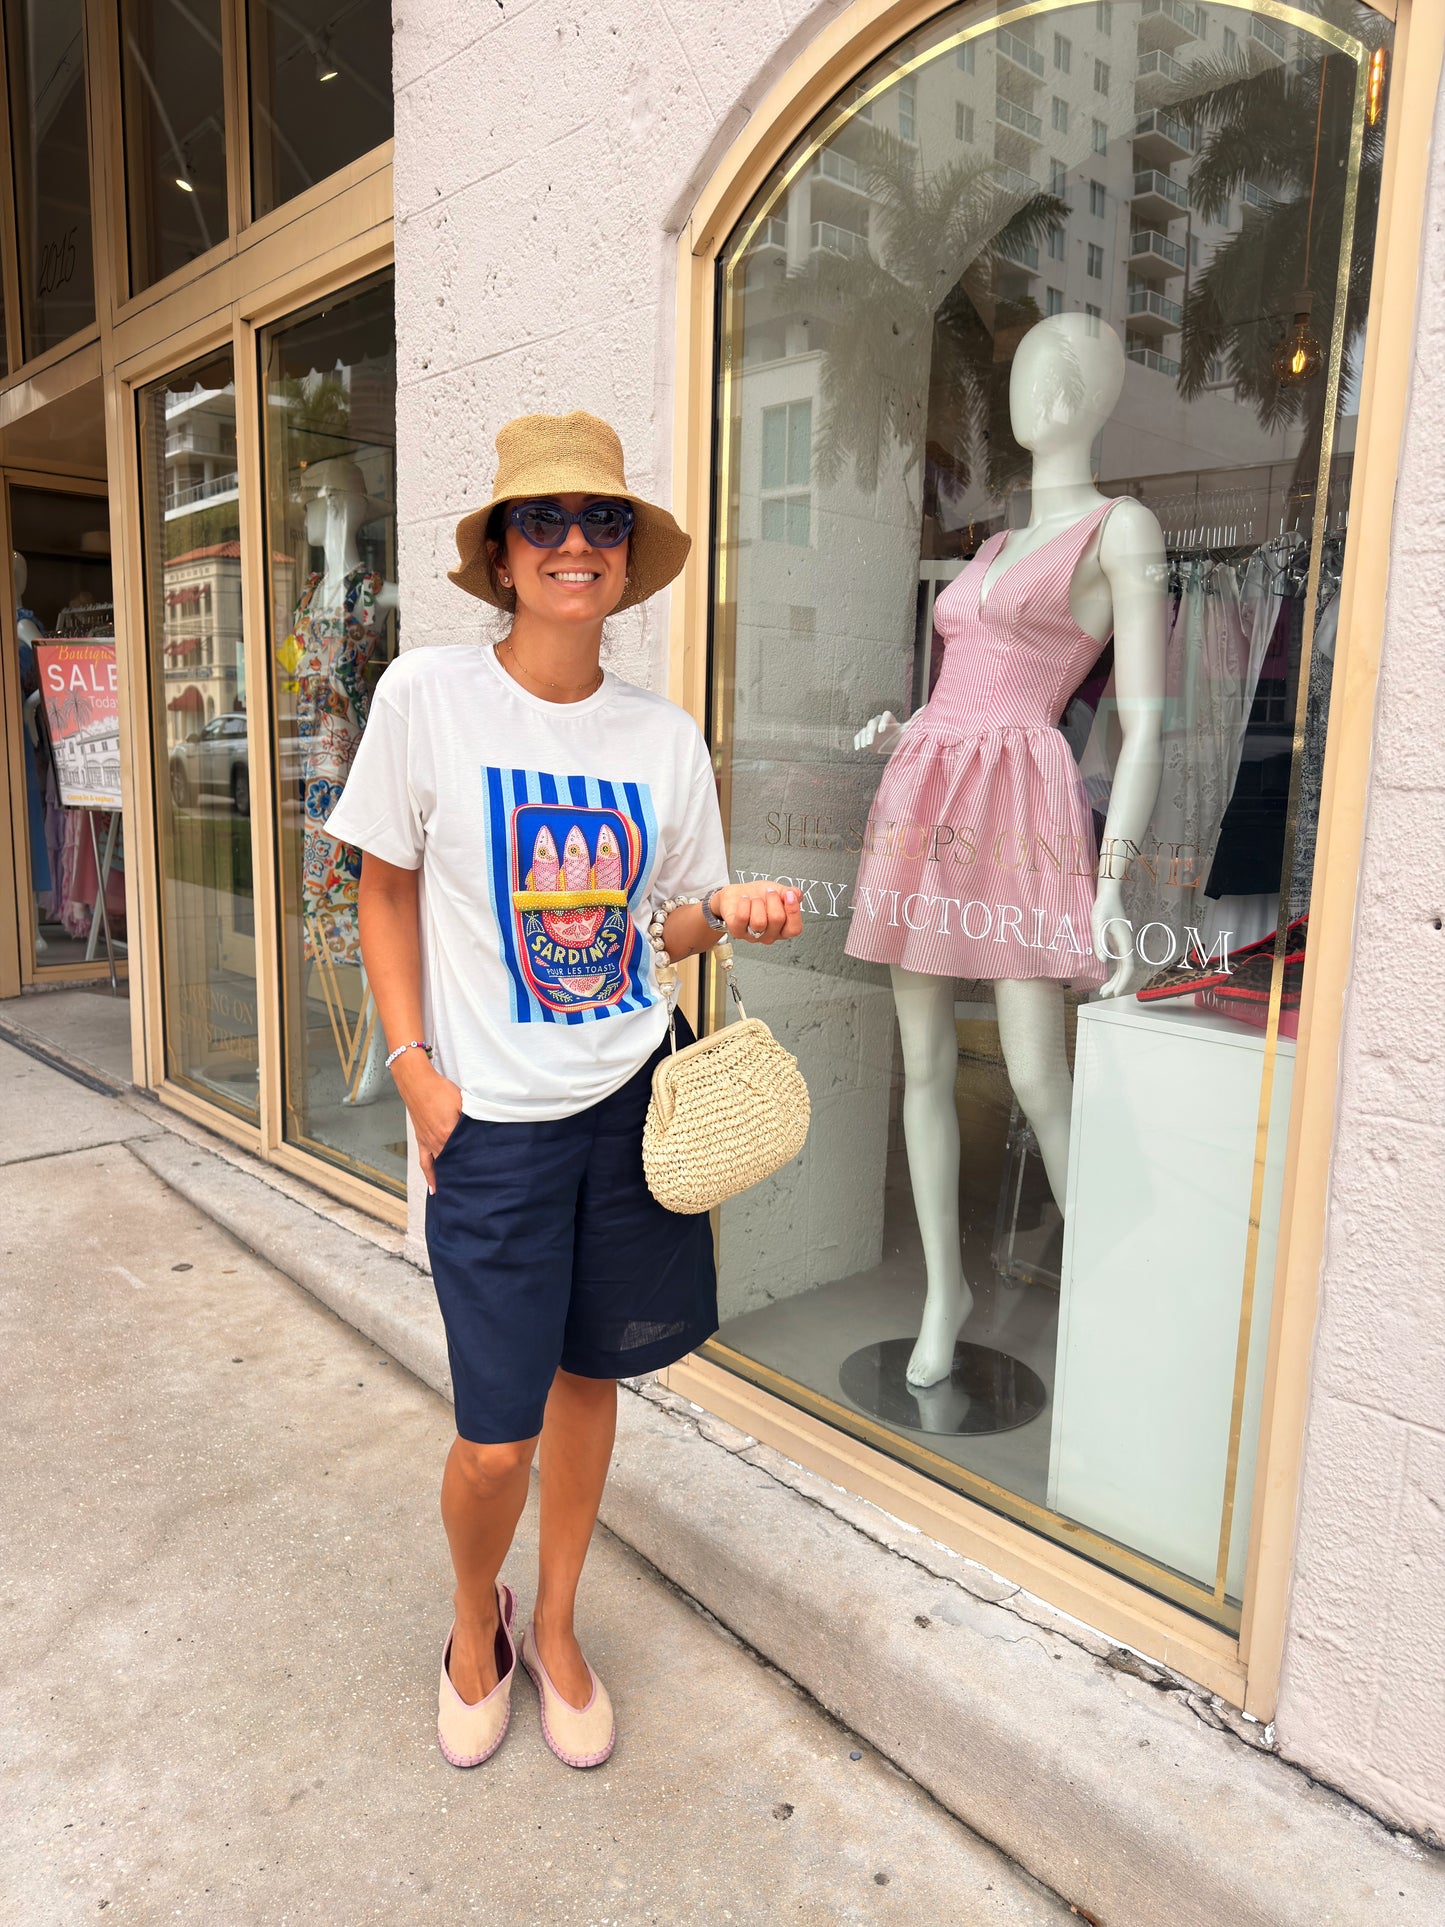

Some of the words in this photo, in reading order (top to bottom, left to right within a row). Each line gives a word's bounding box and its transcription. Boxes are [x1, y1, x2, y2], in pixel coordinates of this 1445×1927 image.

[40, 226, 78, 296] 2015
[47, 664, 117, 692] SALE
[88, 695, 118, 709] Toda
[765, 811, 832, 850] SHE
[845, 818, 976, 865] SHOPS
[995, 831, 1201, 888] ONLINE
[531, 929, 618, 965] SARDINES
[546, 968, 564, 976] POUR
[567, 967, 582, 975] LES
[585, 963, 616, 974] TOASTS
